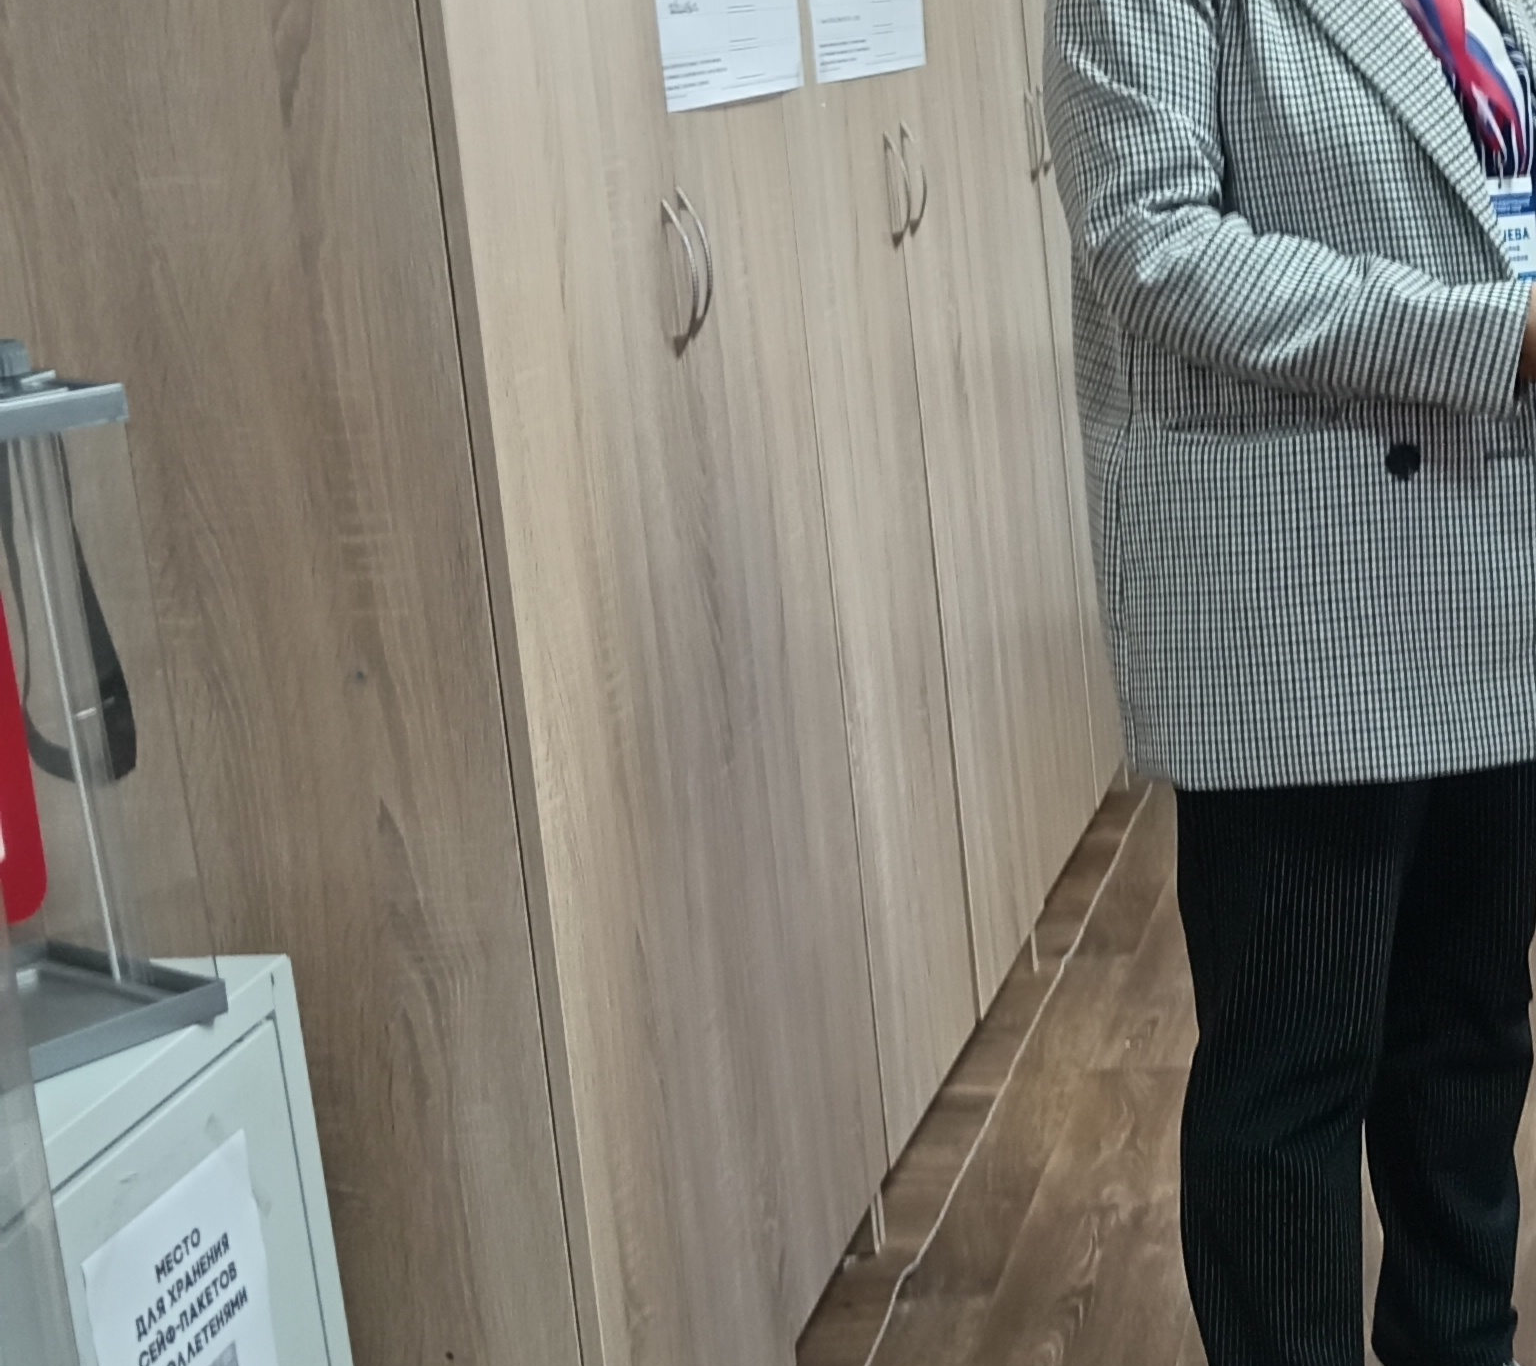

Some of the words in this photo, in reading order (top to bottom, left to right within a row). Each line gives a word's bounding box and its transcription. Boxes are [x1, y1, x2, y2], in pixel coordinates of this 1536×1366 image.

[135, 1296, 167, 1343] ДЛЯ
[167, 1231, 230, 1309] ХРАНЕНИЯ
[154, 1227, 201, 1284] МЕСТО
